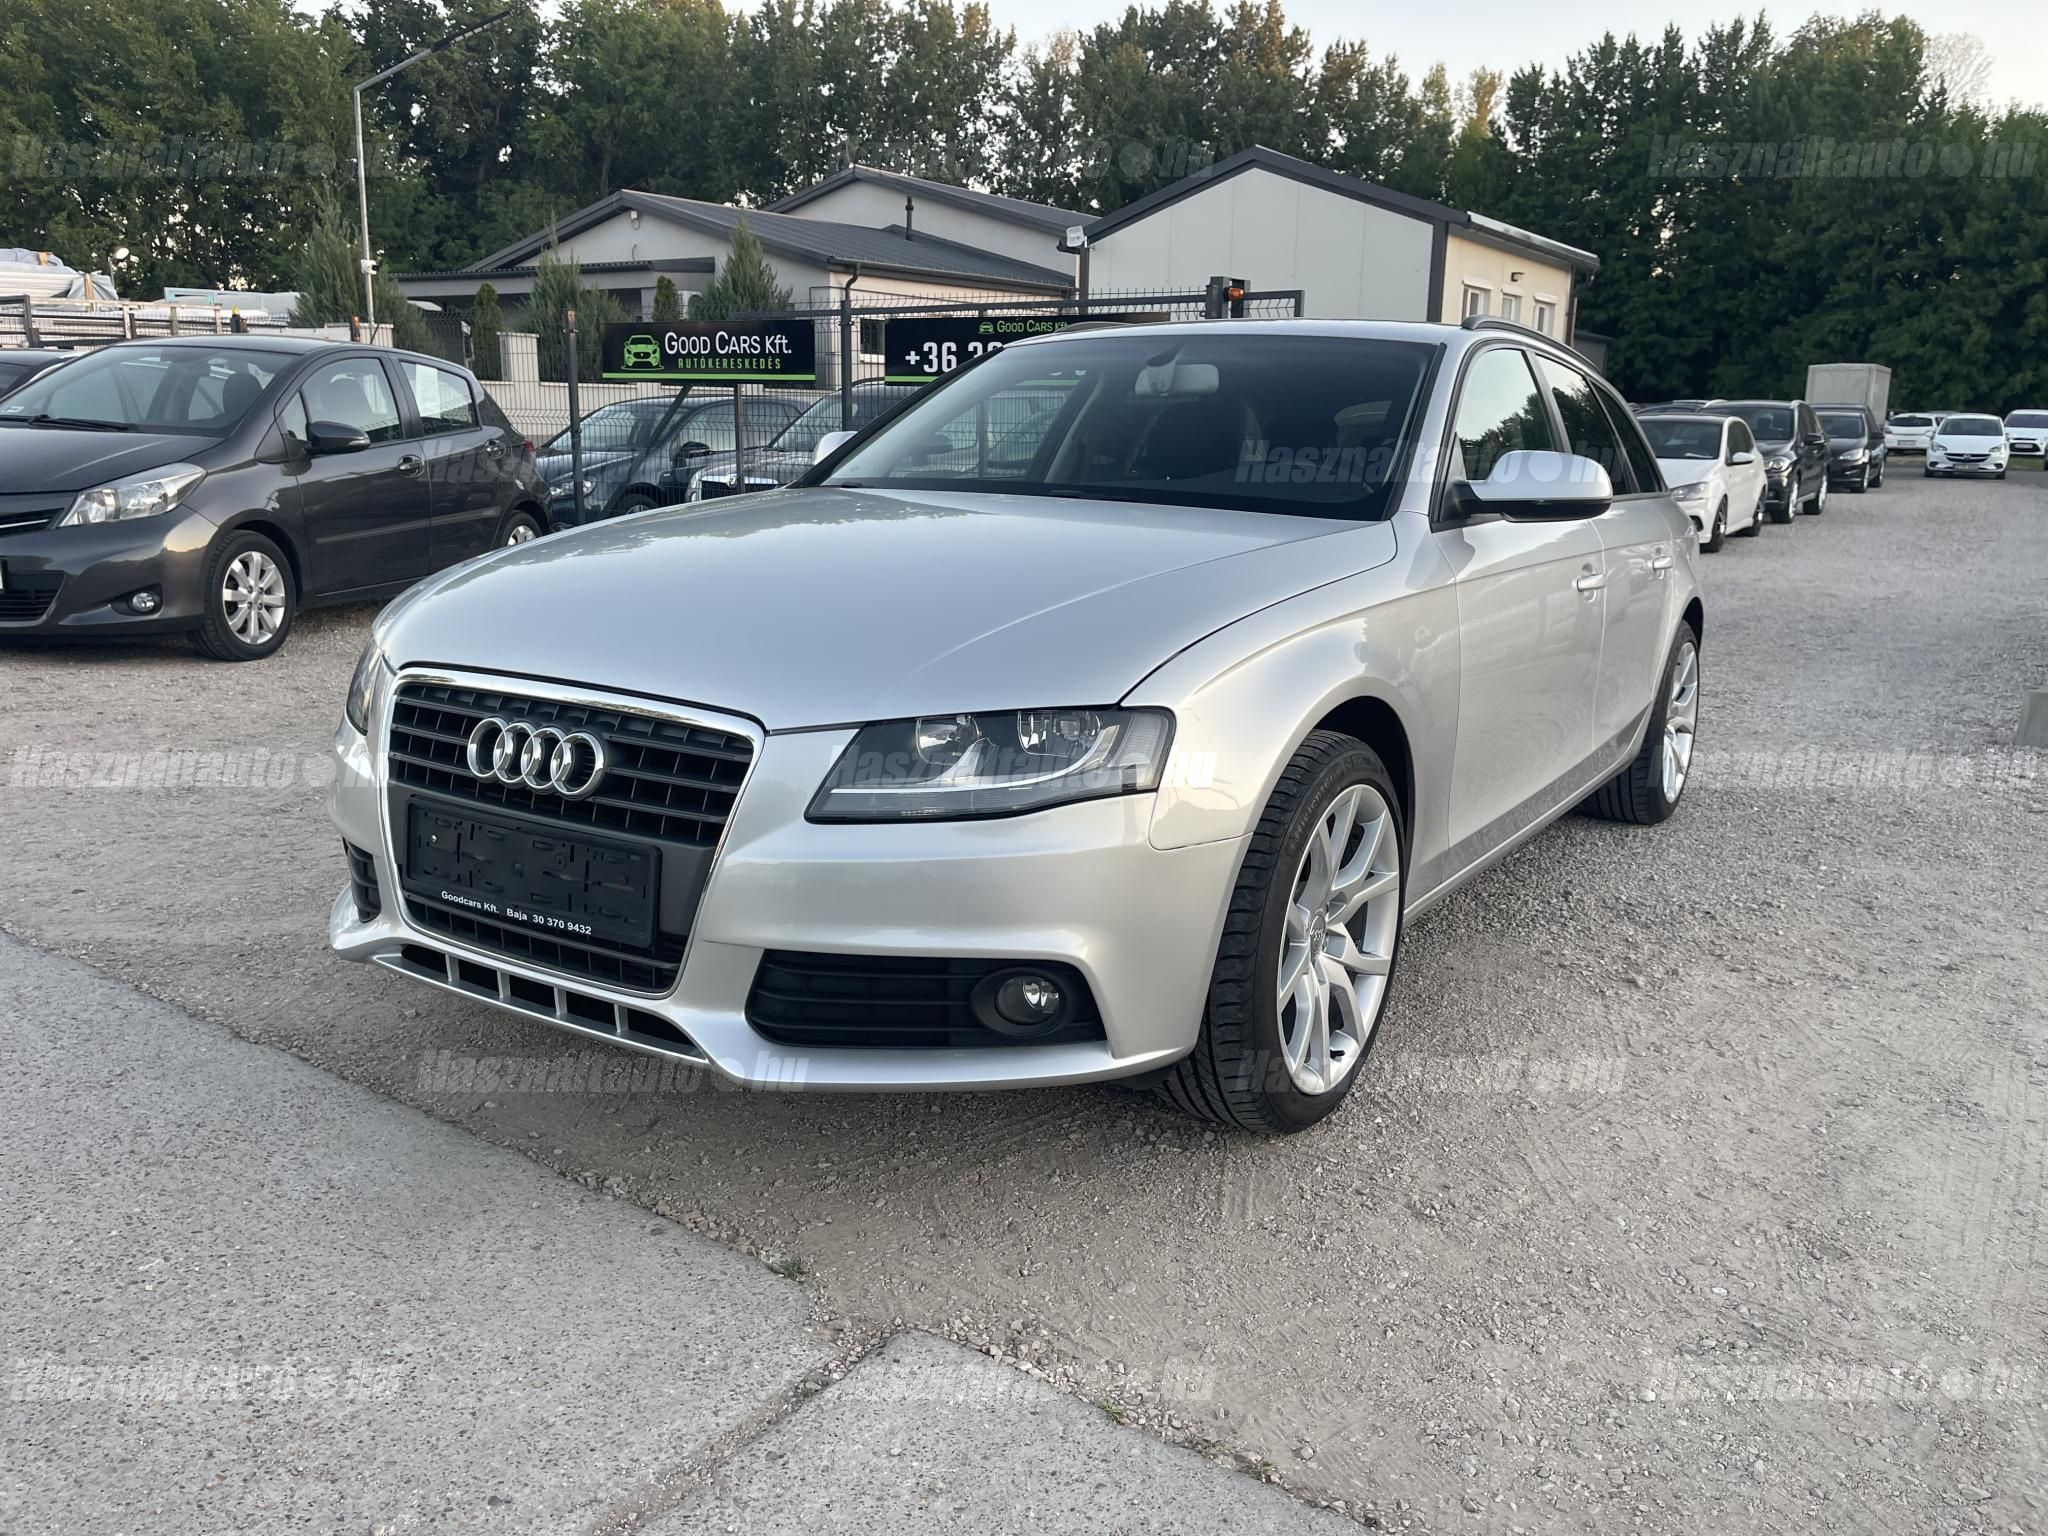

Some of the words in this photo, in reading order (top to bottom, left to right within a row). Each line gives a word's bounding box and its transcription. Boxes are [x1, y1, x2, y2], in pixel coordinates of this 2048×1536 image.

[997, 320, 1024, 332] GOOD
[1026, 319, 1053, 332] CARS
[664, 331, 711, 355] GOOD
[715, 331, 761, 354] CARS
[765, 334, 792, 354] Kft.
[678, 355, 781, 369] AUTÓKERESKEDÉS
[905, 341, 958, 373] +36
[441, 890, 482, 909] Goodcars
[484, 902, 500, 914] Kft.
[506, 908, 528, 921] Baja
[532, 914, 545, 925] 30
[547, 917, 565, 929] 370
[567, 921, 592, 935] 9432
